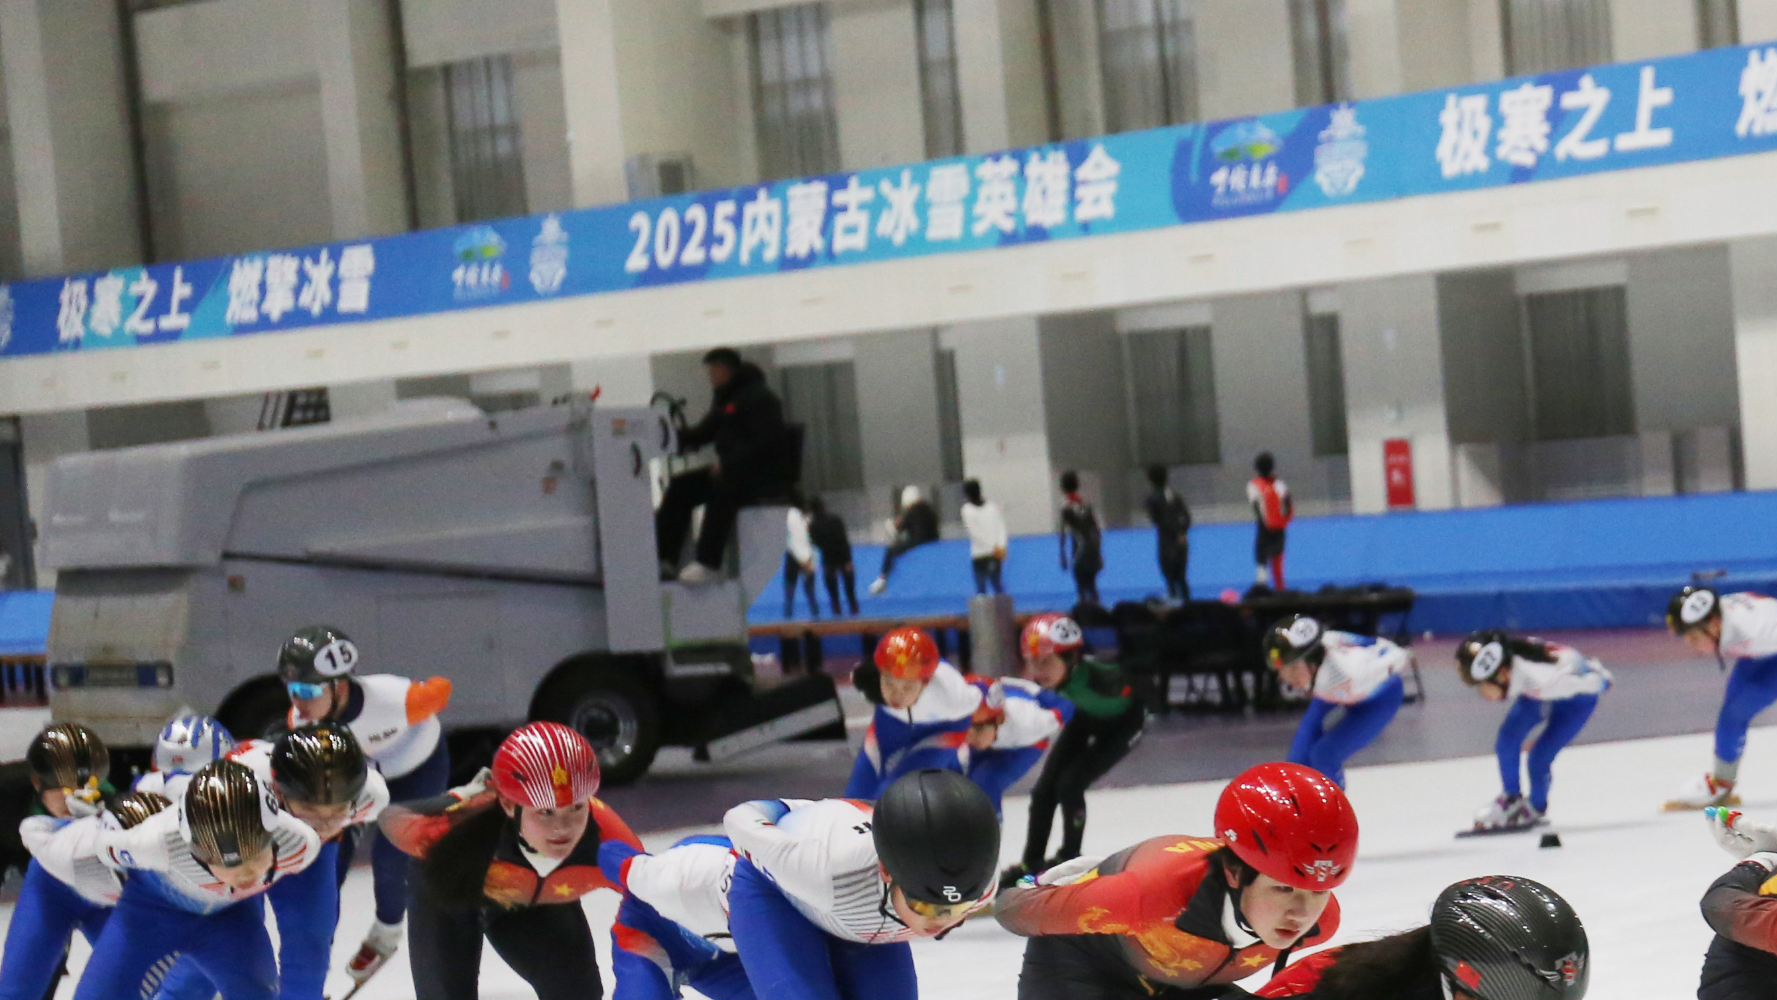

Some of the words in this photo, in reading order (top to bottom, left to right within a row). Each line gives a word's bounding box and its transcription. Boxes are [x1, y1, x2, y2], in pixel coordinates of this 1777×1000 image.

[1435, 67, 1675, 178] 极寒之上
[625, 144, 1121, 273] 2025内蒙古冰雪英雄会
[57, 265, 193, 343] 极寒之上
[226, 244, 376, 325] 燃擎冰雪
[324, 644, 353, 670] 15
